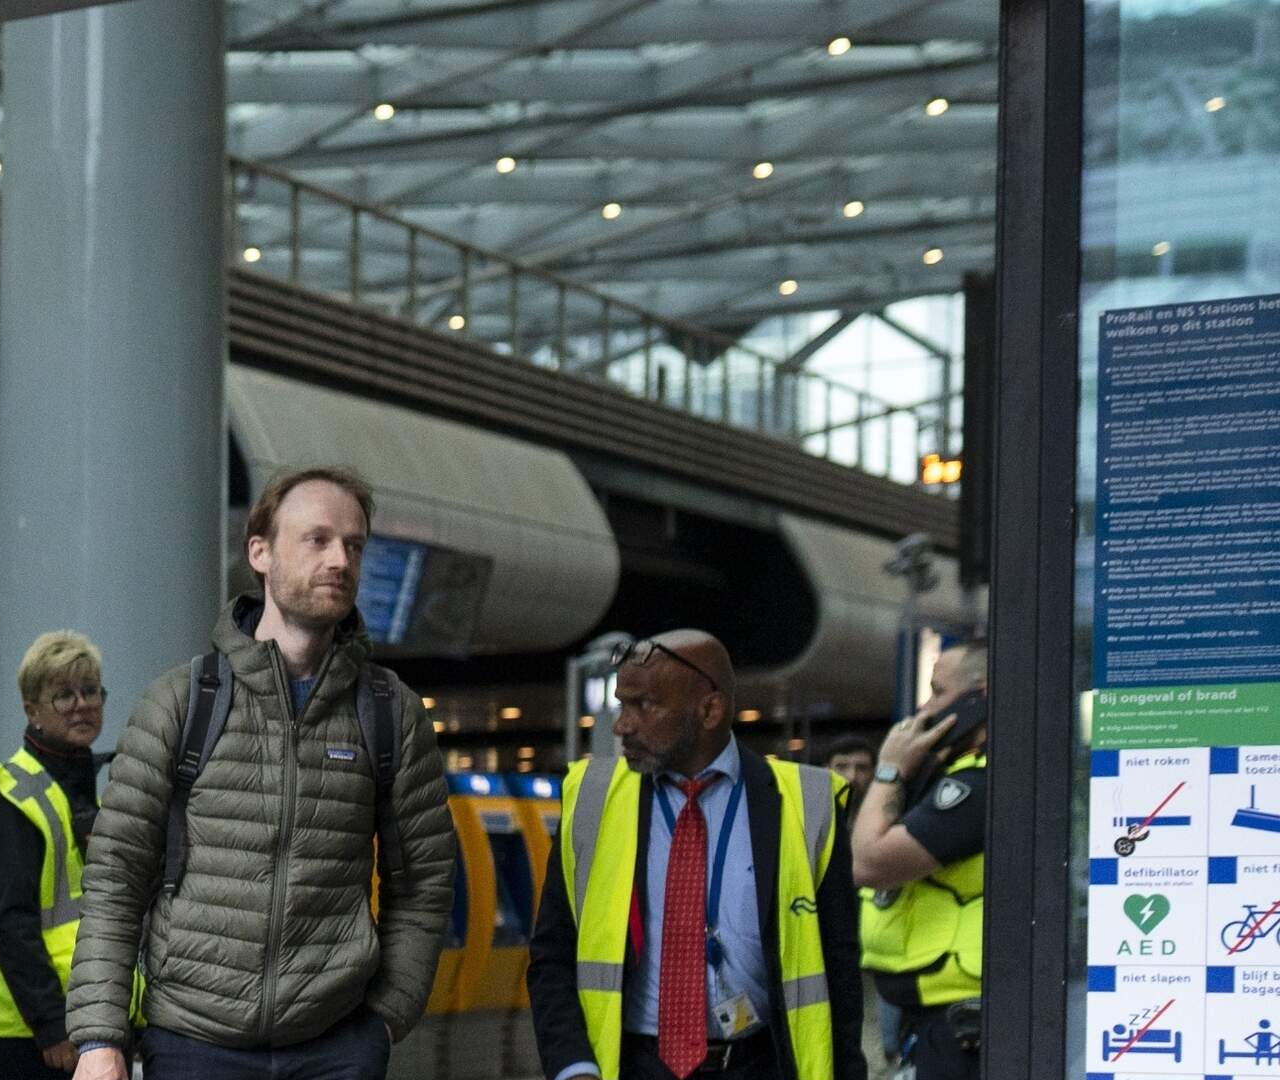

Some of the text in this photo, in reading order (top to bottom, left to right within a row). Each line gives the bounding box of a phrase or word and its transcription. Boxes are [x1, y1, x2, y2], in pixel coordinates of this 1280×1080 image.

[1105, 310, 1153, 325] ProRail
[1155, 310, 1174, 320] en
[1176, 305, 1194, 318] NS
[1198, 301, 1256, 316] Stations
[1105, 315, 1255, 338] welkom op dit station
[1099, 688, 1238, 706] Bij ongeval of brand
[1125, 756, 1190, 767] niet roken
[1124, 867, 1200, 878] defibrillator
[1243, 864, 1268, 874] niet
[1122, 973, 1192, 985] niet slapen
[1242, 971, 1268, 983] blijf
